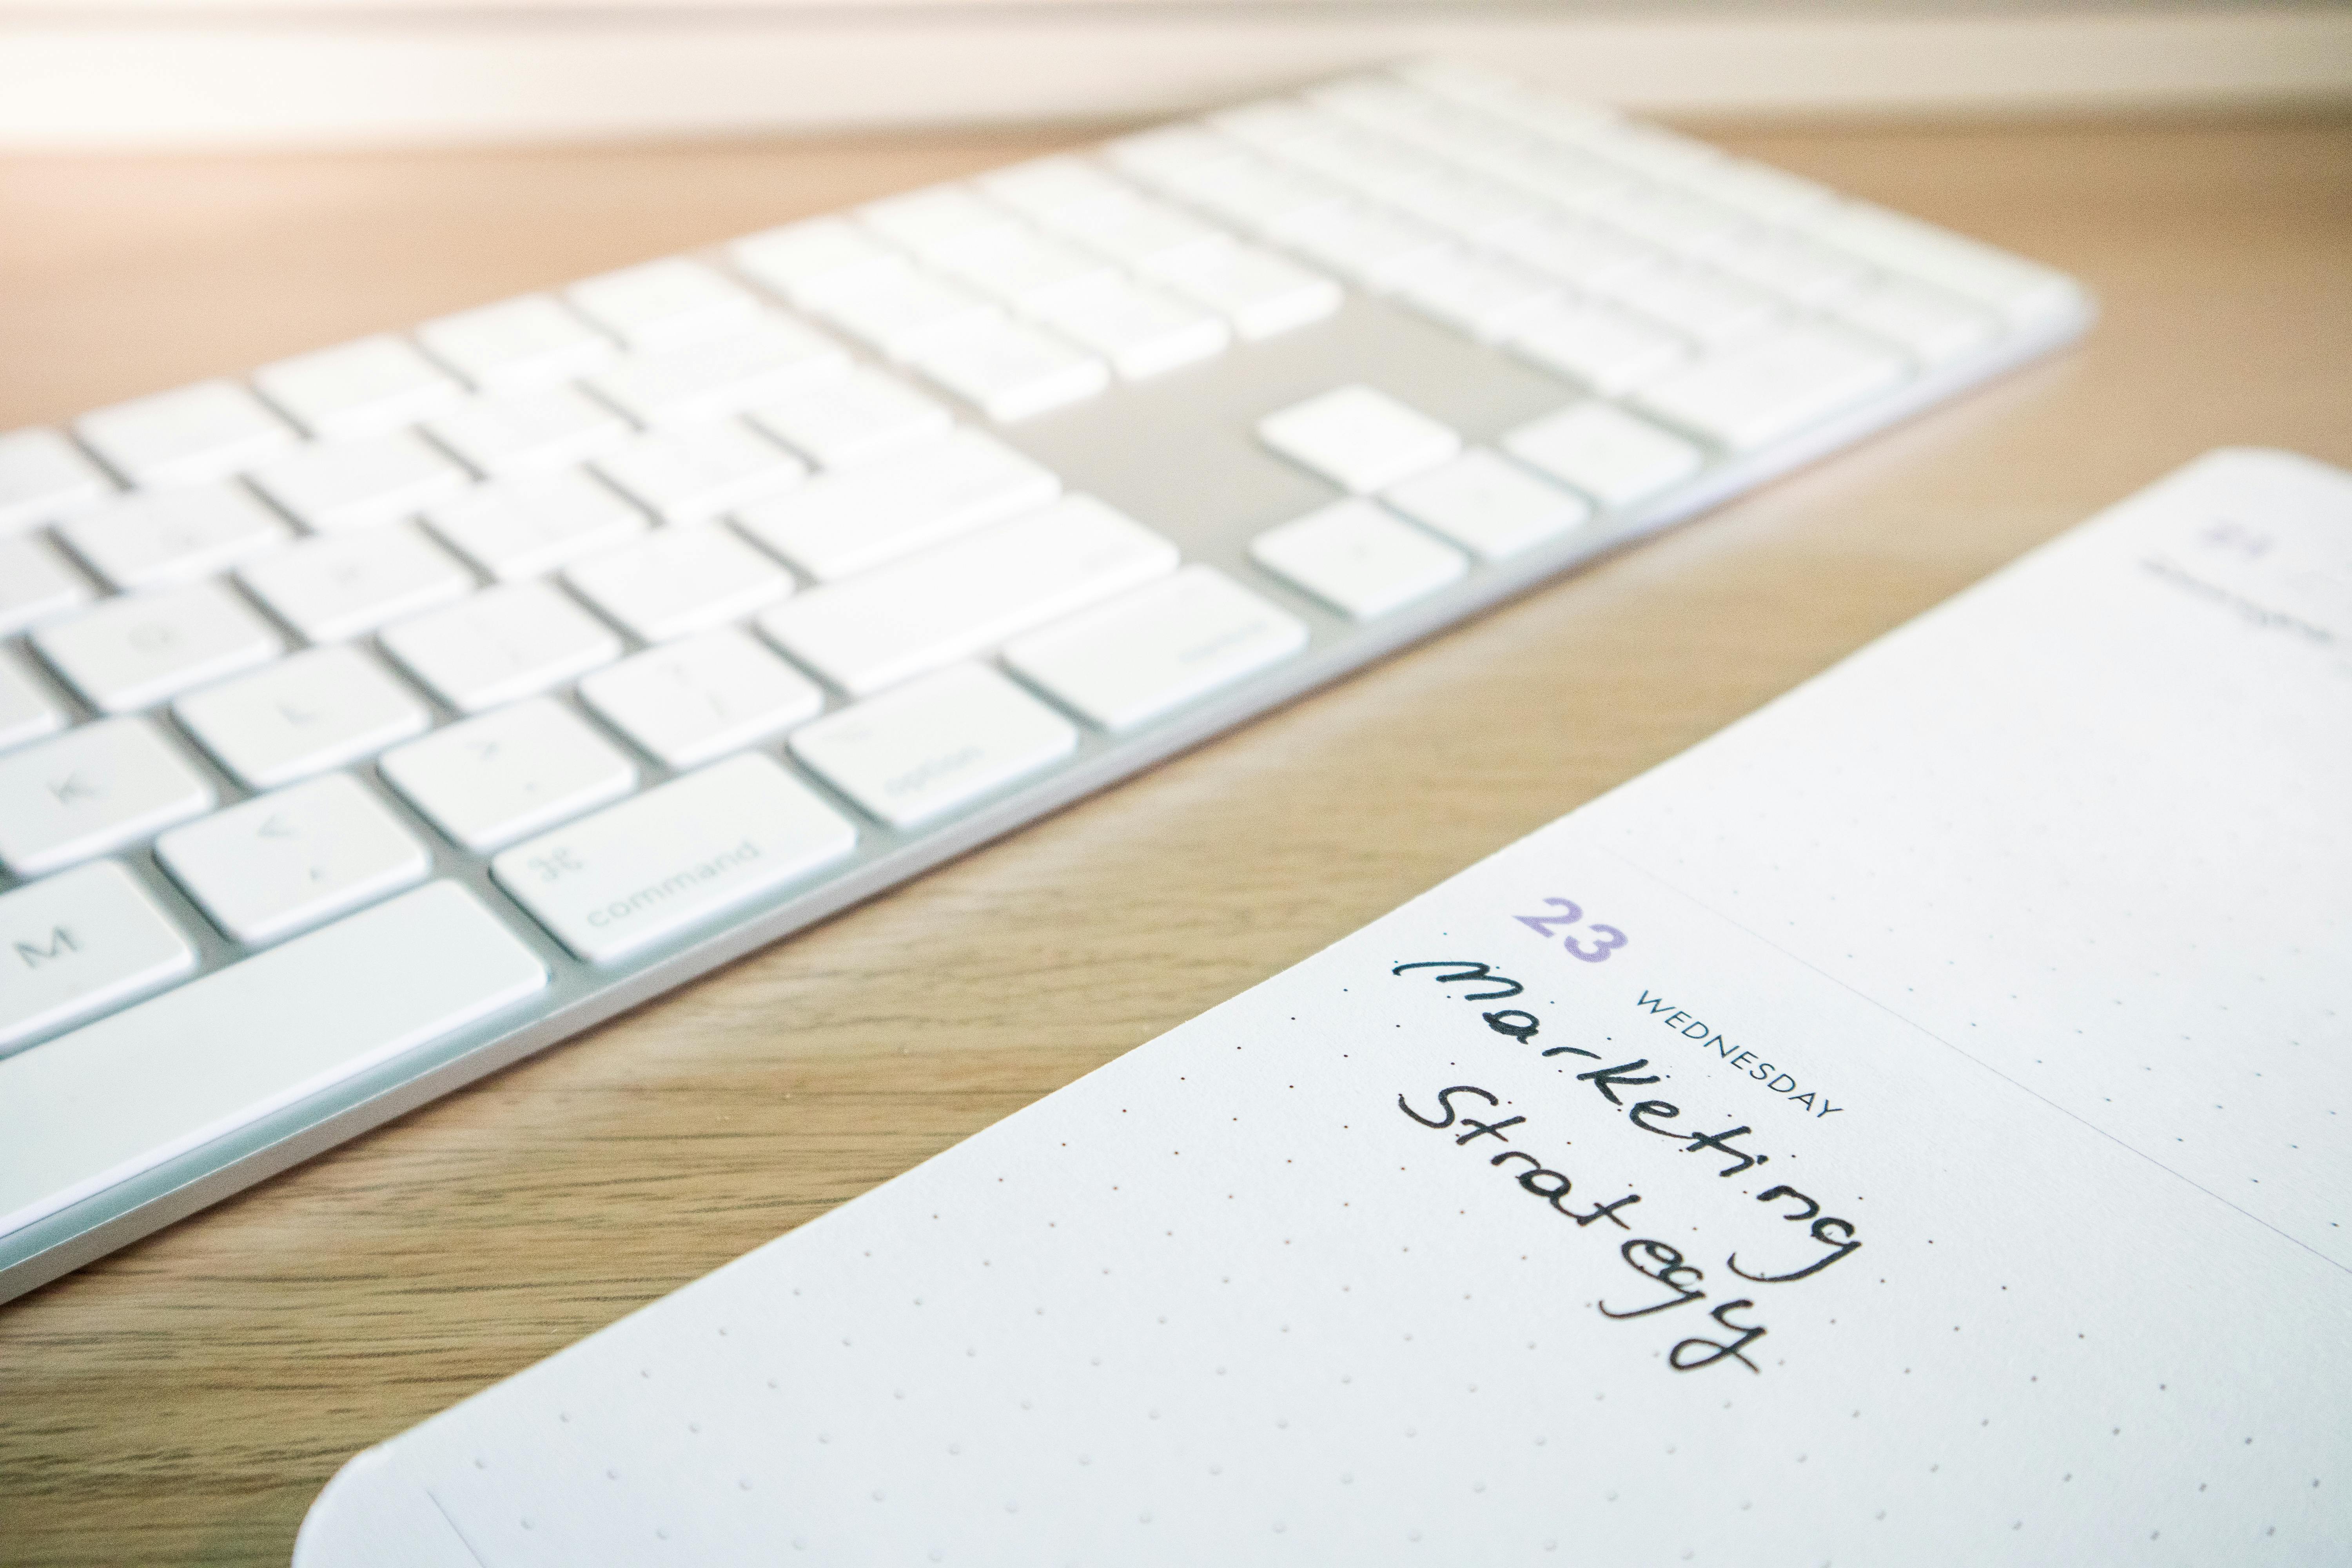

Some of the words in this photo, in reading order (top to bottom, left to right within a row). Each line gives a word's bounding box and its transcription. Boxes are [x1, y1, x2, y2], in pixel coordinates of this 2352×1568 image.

[45, 769, 104, 806] K
[883, 745, 985, 797] option
[586, 839, 761, 928] command
[12, 924, 84, 969] M
[1512, 896, 1628, 962] 23
[1636, 989, 1844, 1119] WEDNESDAY
[1397, 1084, 1769, 1375] Strategy
